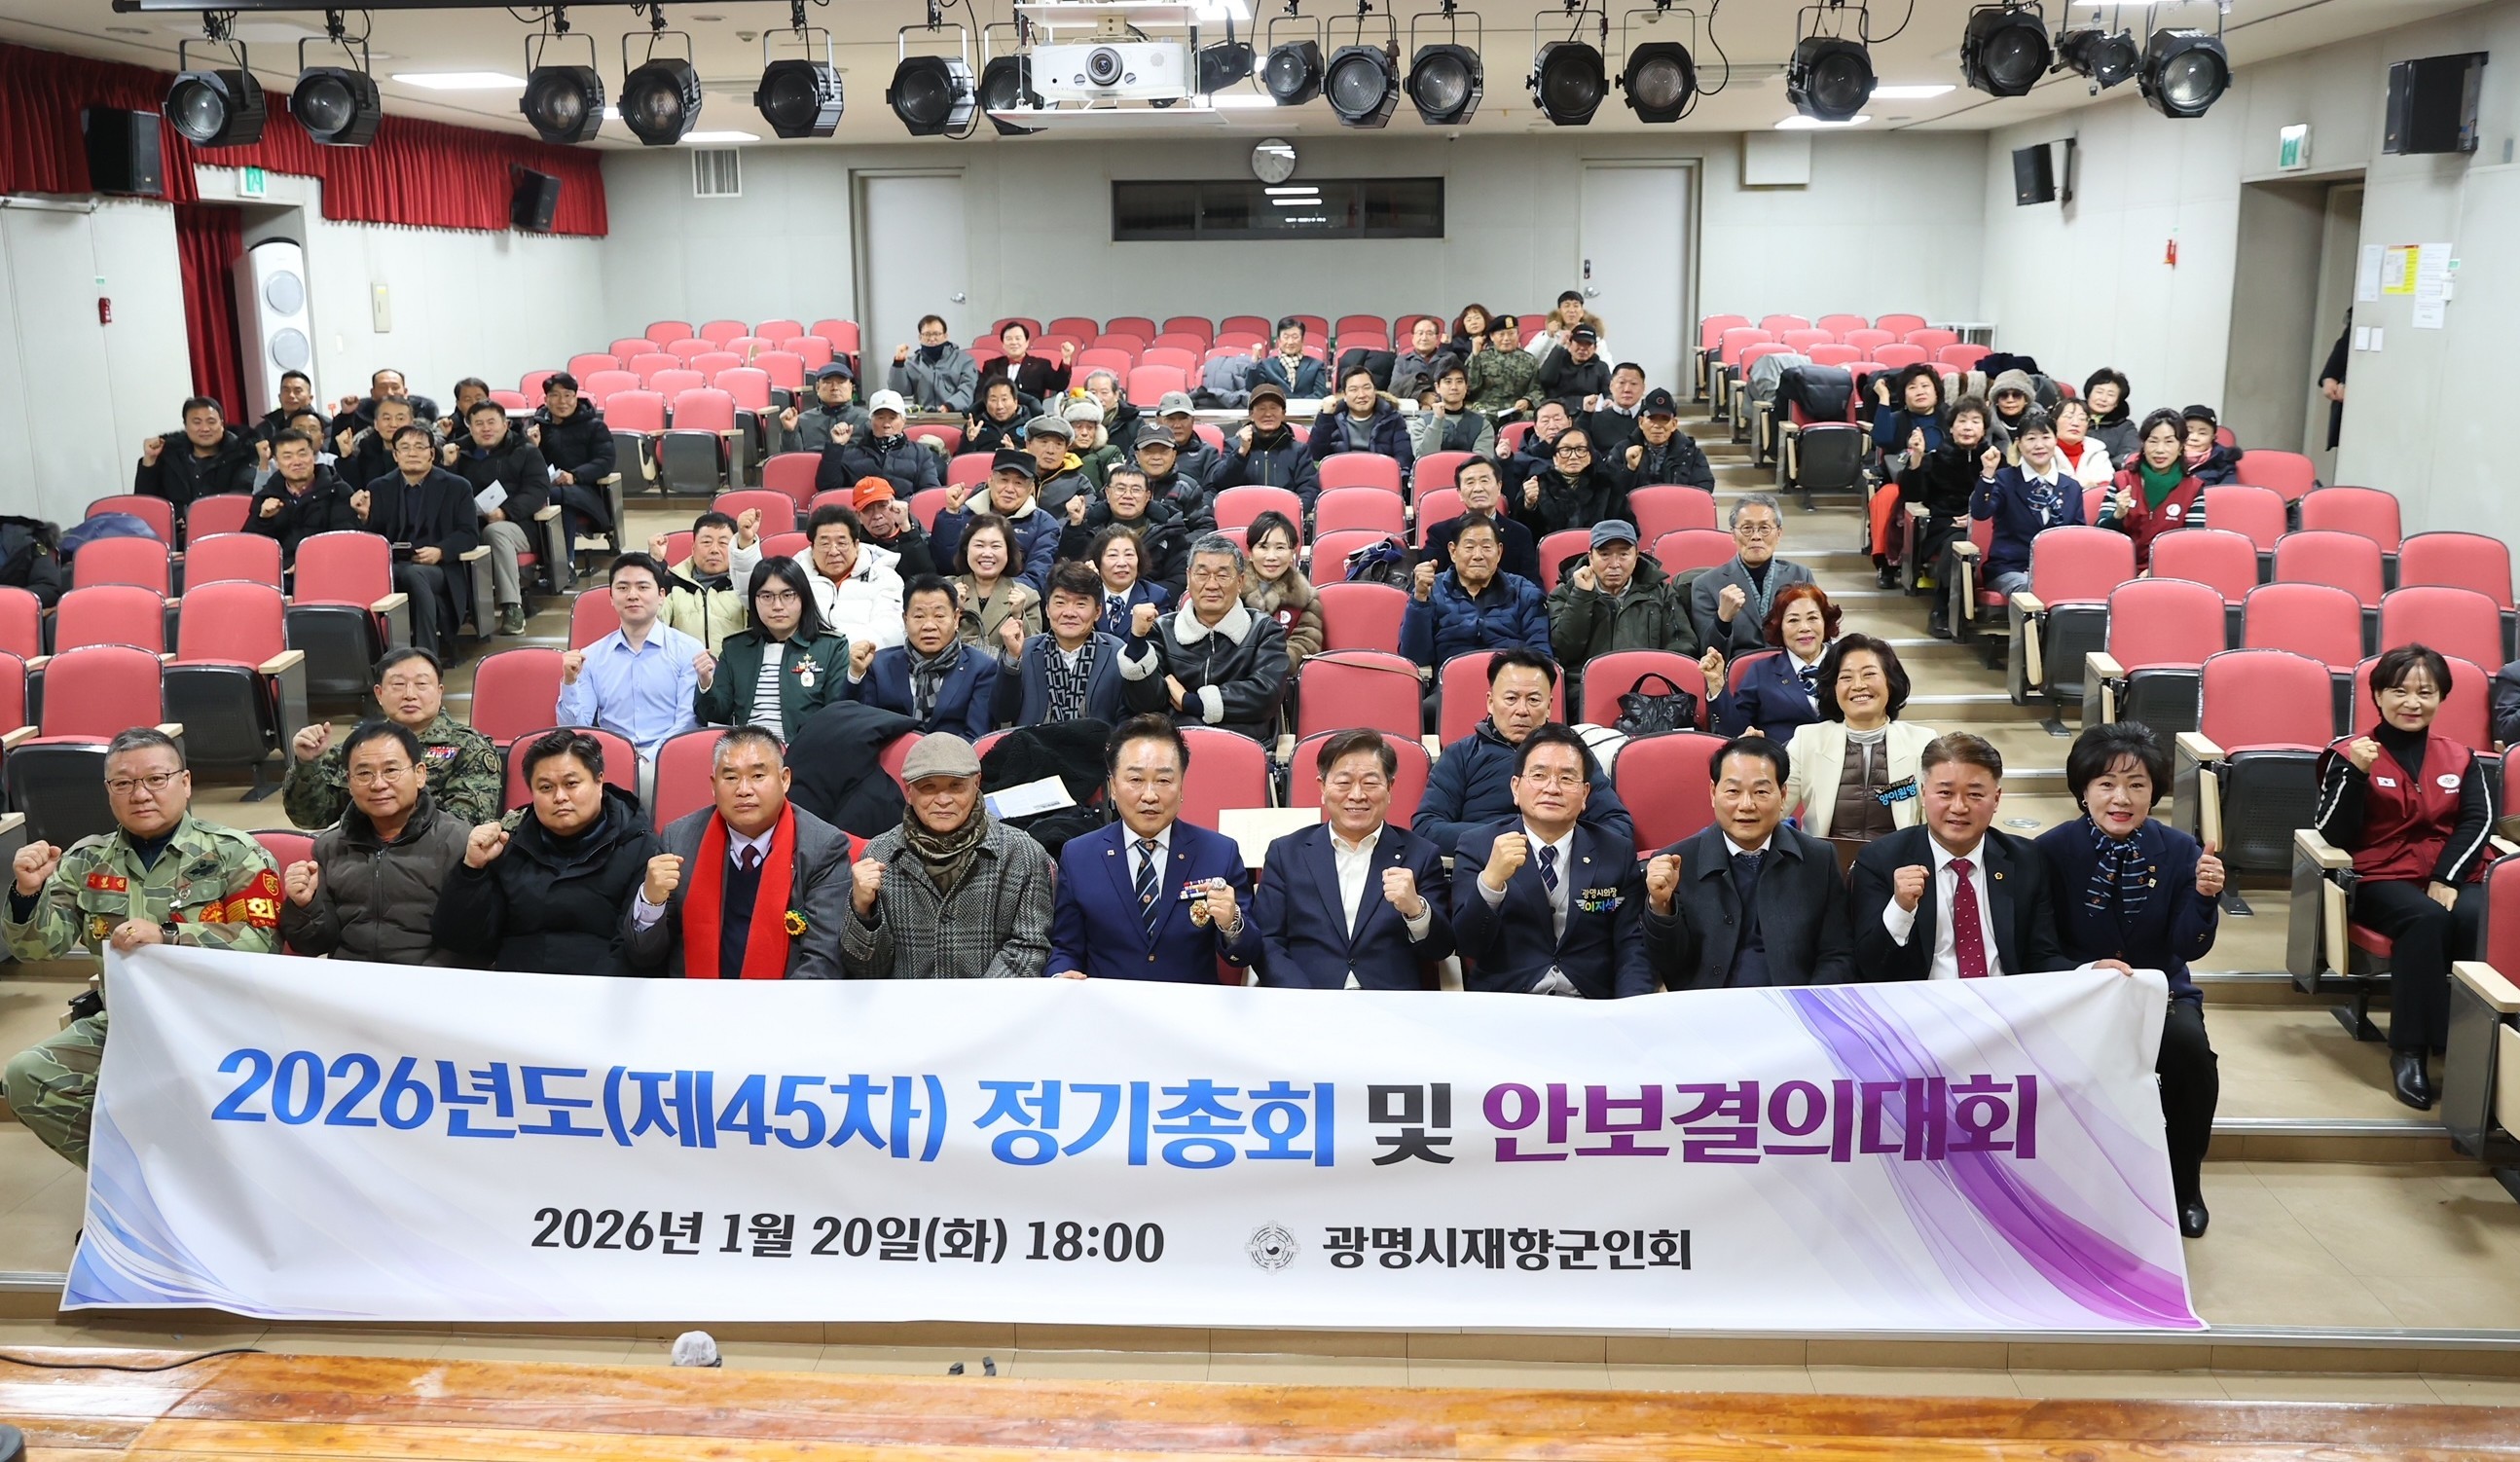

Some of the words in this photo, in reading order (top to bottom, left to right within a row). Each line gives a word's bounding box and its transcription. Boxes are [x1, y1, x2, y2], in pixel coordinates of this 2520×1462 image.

[1879, 784, 1917, 806] 양이원영
[1582, 888, 1617, 899] 광명시의장
[1585, 898, 1616, 913] 이지석
[211, 1047, 948, 1162] 2026년도(제45차)
[973, 1078, 1335, 1170] 정기총회
[1367, 1082, 1455, 1167] 및
[1481, 1073, 2037, 1165] 안보결의대회
[530, 1207, 704, 1258] 2026년
[719, 1213, 796, 1260] 1월
[810, 1217, 1008, 1265] 20일(화)
[1025, 1222, 1165, 1264] 18:00
[1323, 1226, 1693, 1271] 광명시재향군인회
